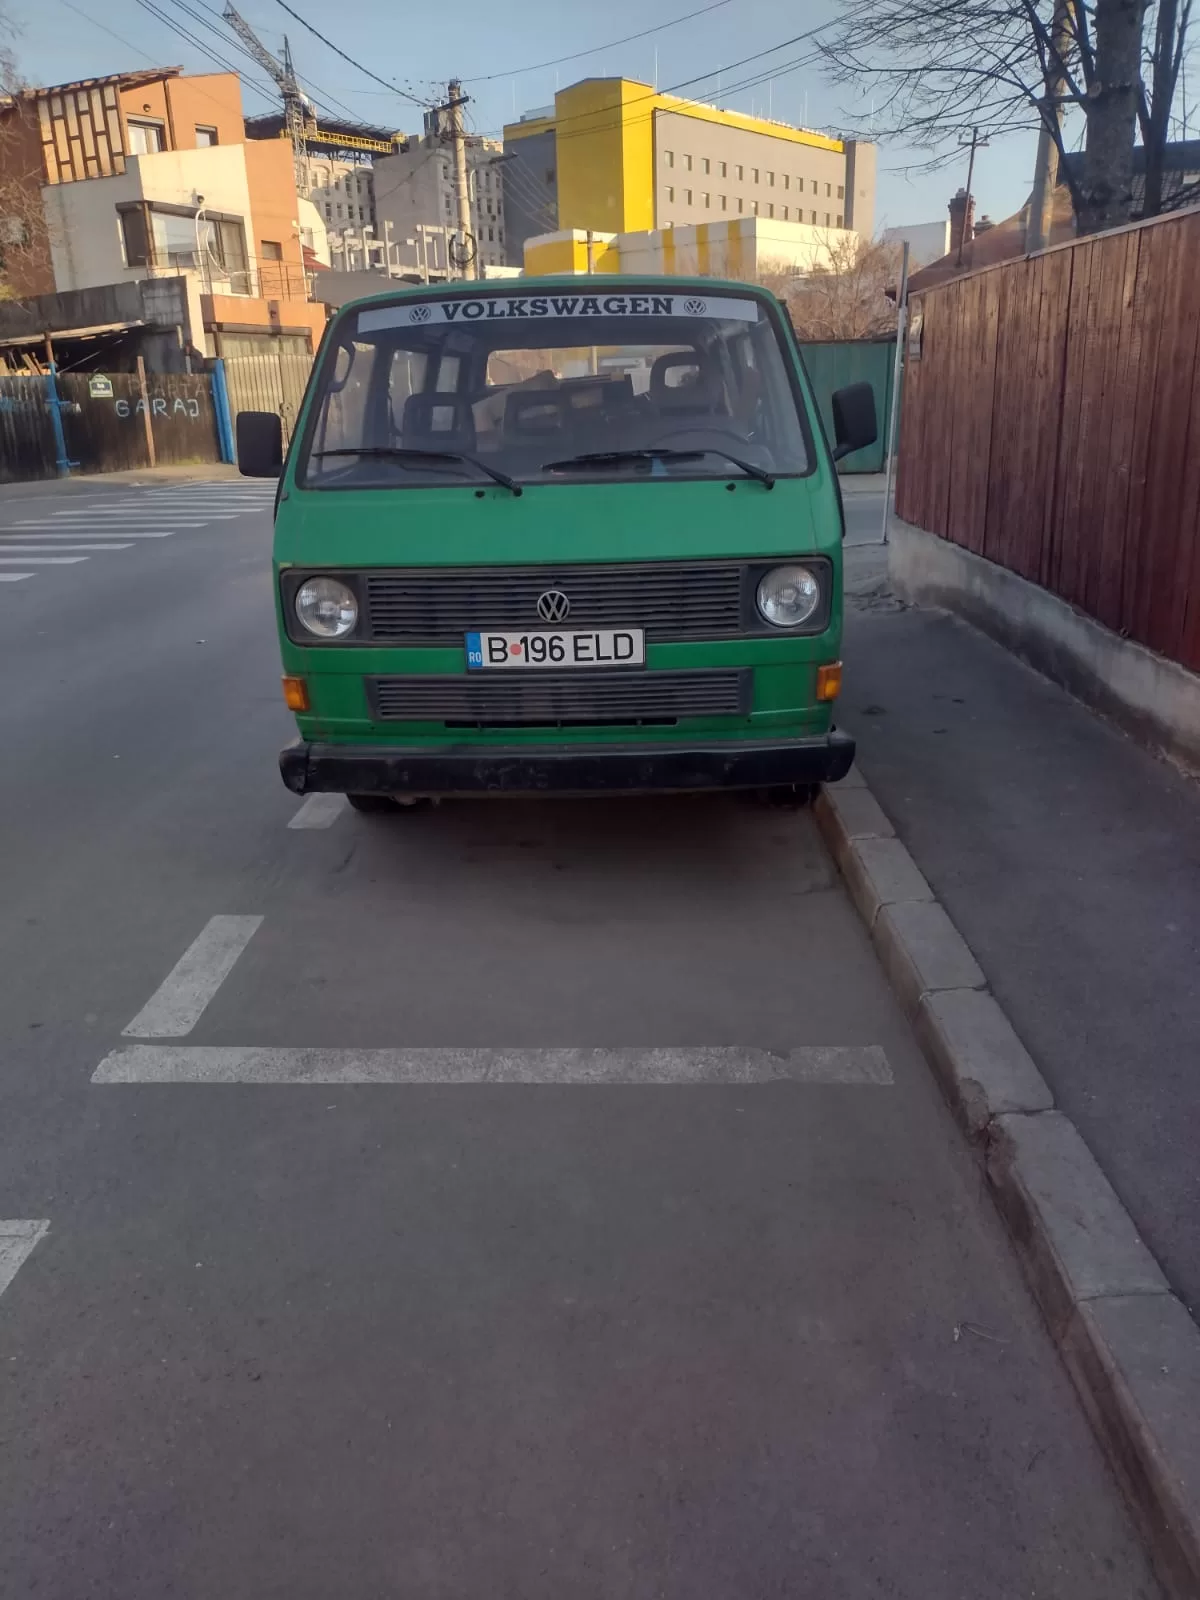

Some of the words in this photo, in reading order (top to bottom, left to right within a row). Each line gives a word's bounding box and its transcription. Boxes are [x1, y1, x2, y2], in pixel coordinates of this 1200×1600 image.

[441, 297, 674, 321] VOLKSWAGEN
[115, 397, 200, 419] GARAJ
[468, 651, 481, 663] RO
[488, 636, 508, 663] B
[520, 635, 565, 662] 196
[573, 633, 634, 662] ELD
